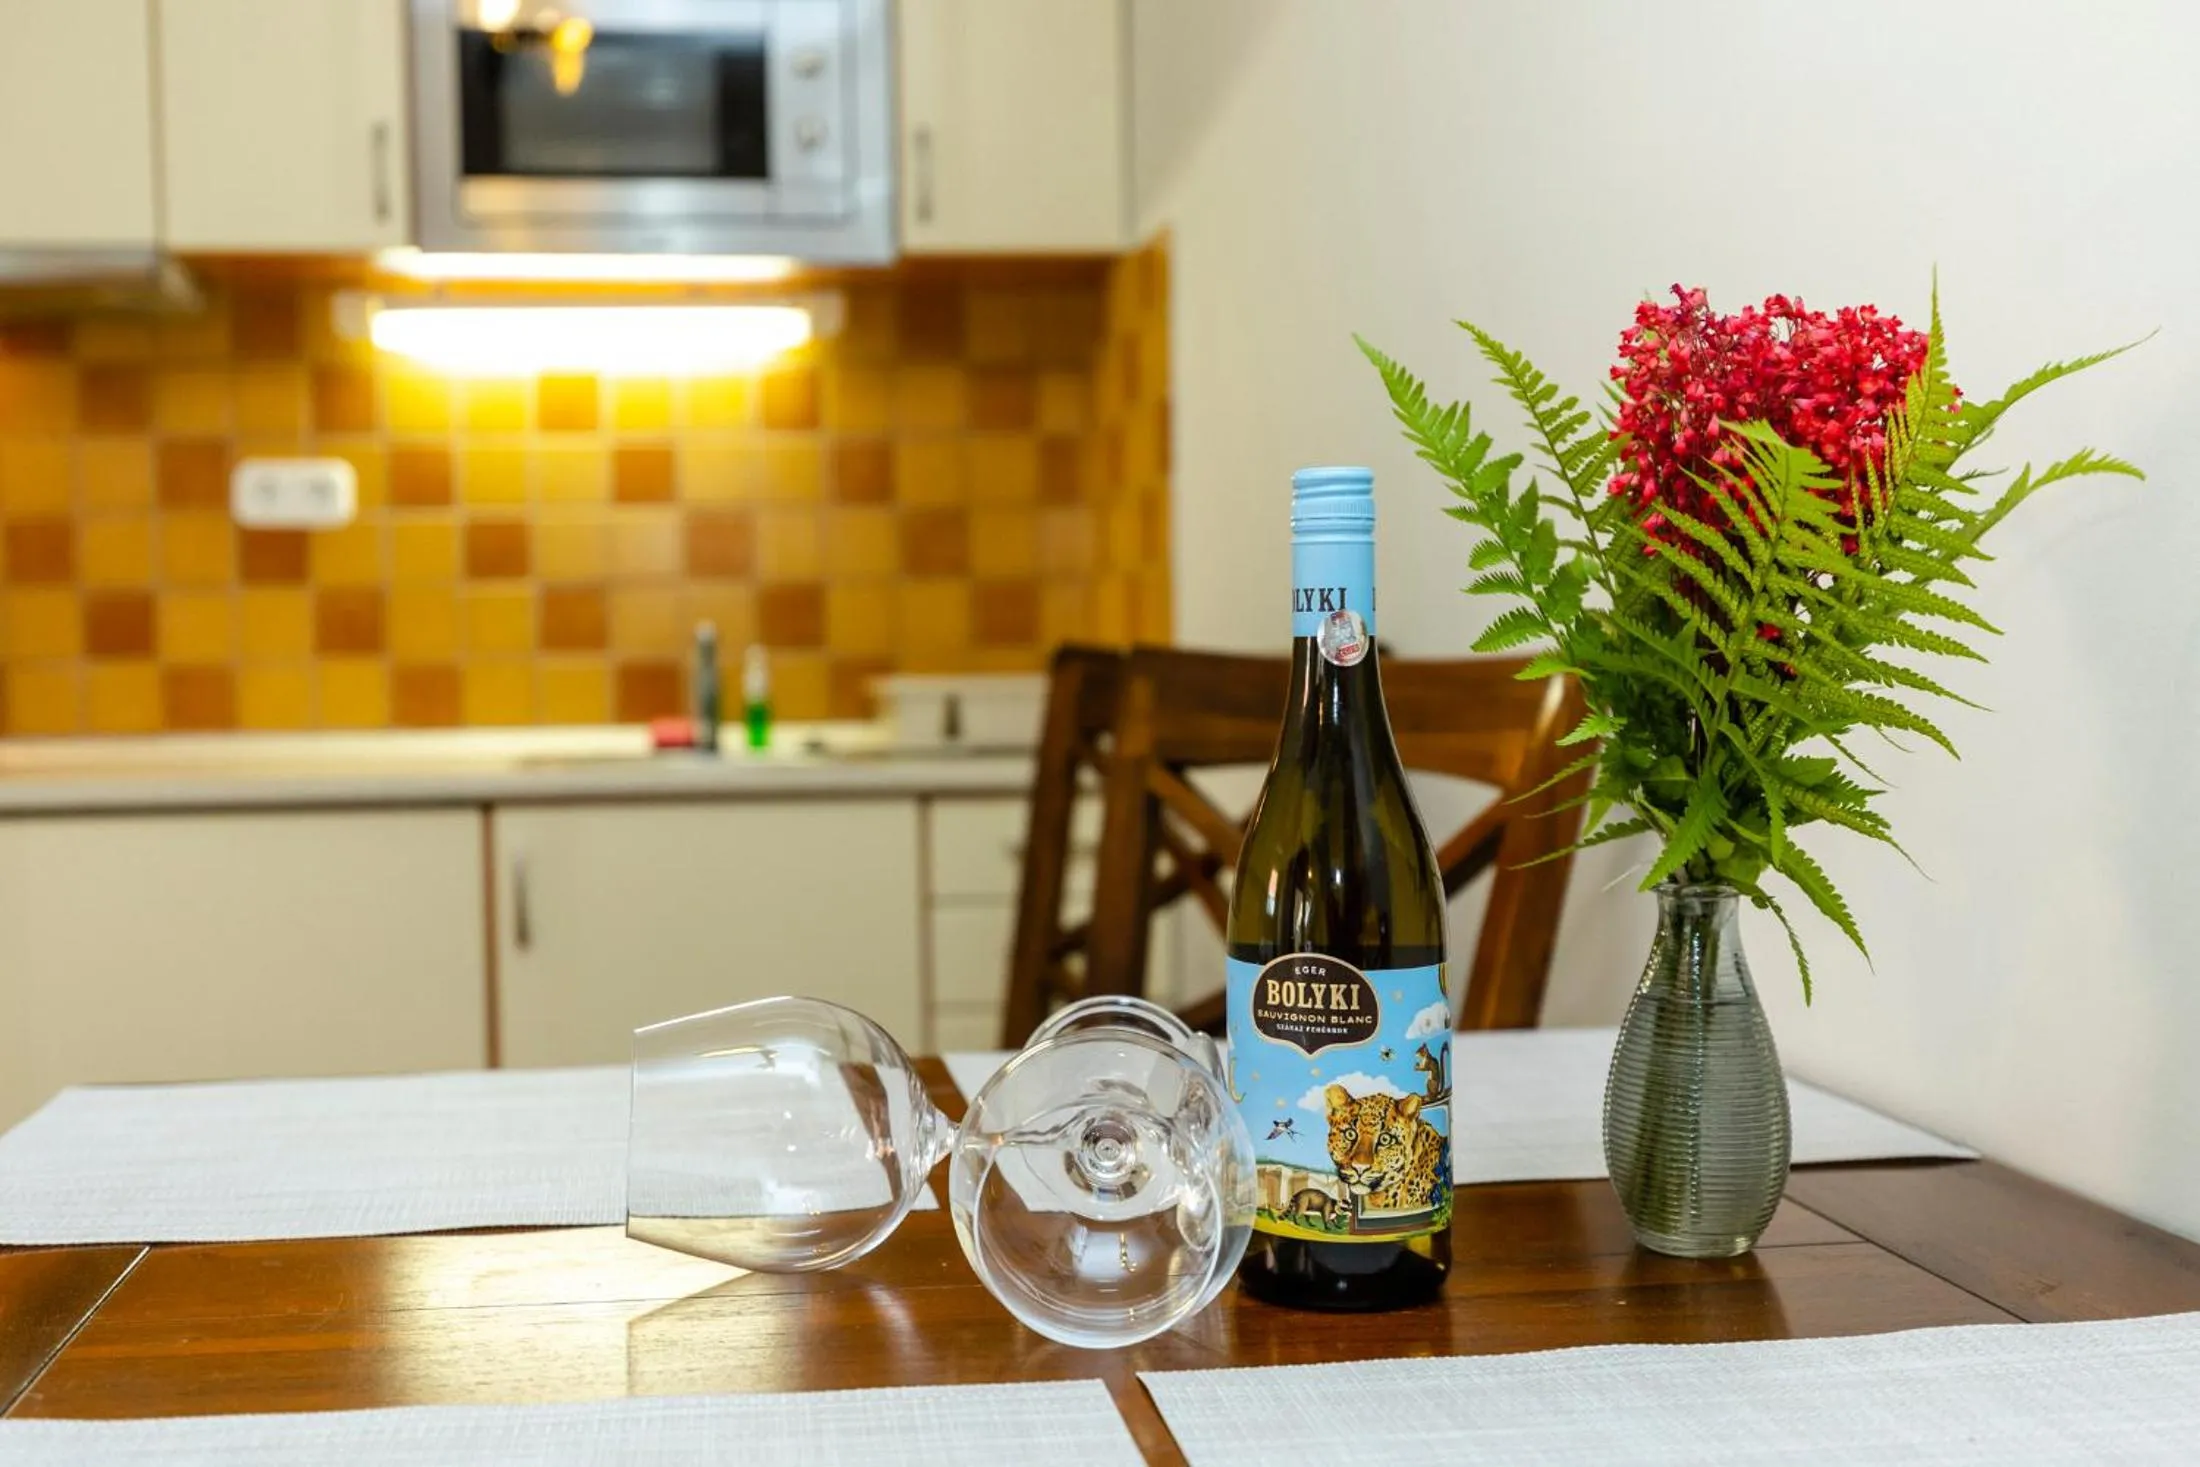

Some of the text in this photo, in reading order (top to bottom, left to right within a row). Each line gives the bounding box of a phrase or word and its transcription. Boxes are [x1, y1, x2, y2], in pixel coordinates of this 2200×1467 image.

[1295, 966, 1326, 976] EGER
[1267, 980, 1360, 1010] BOLYKI
[1257, 1009, 1373, 1025] SAUVIGNON BLANC
